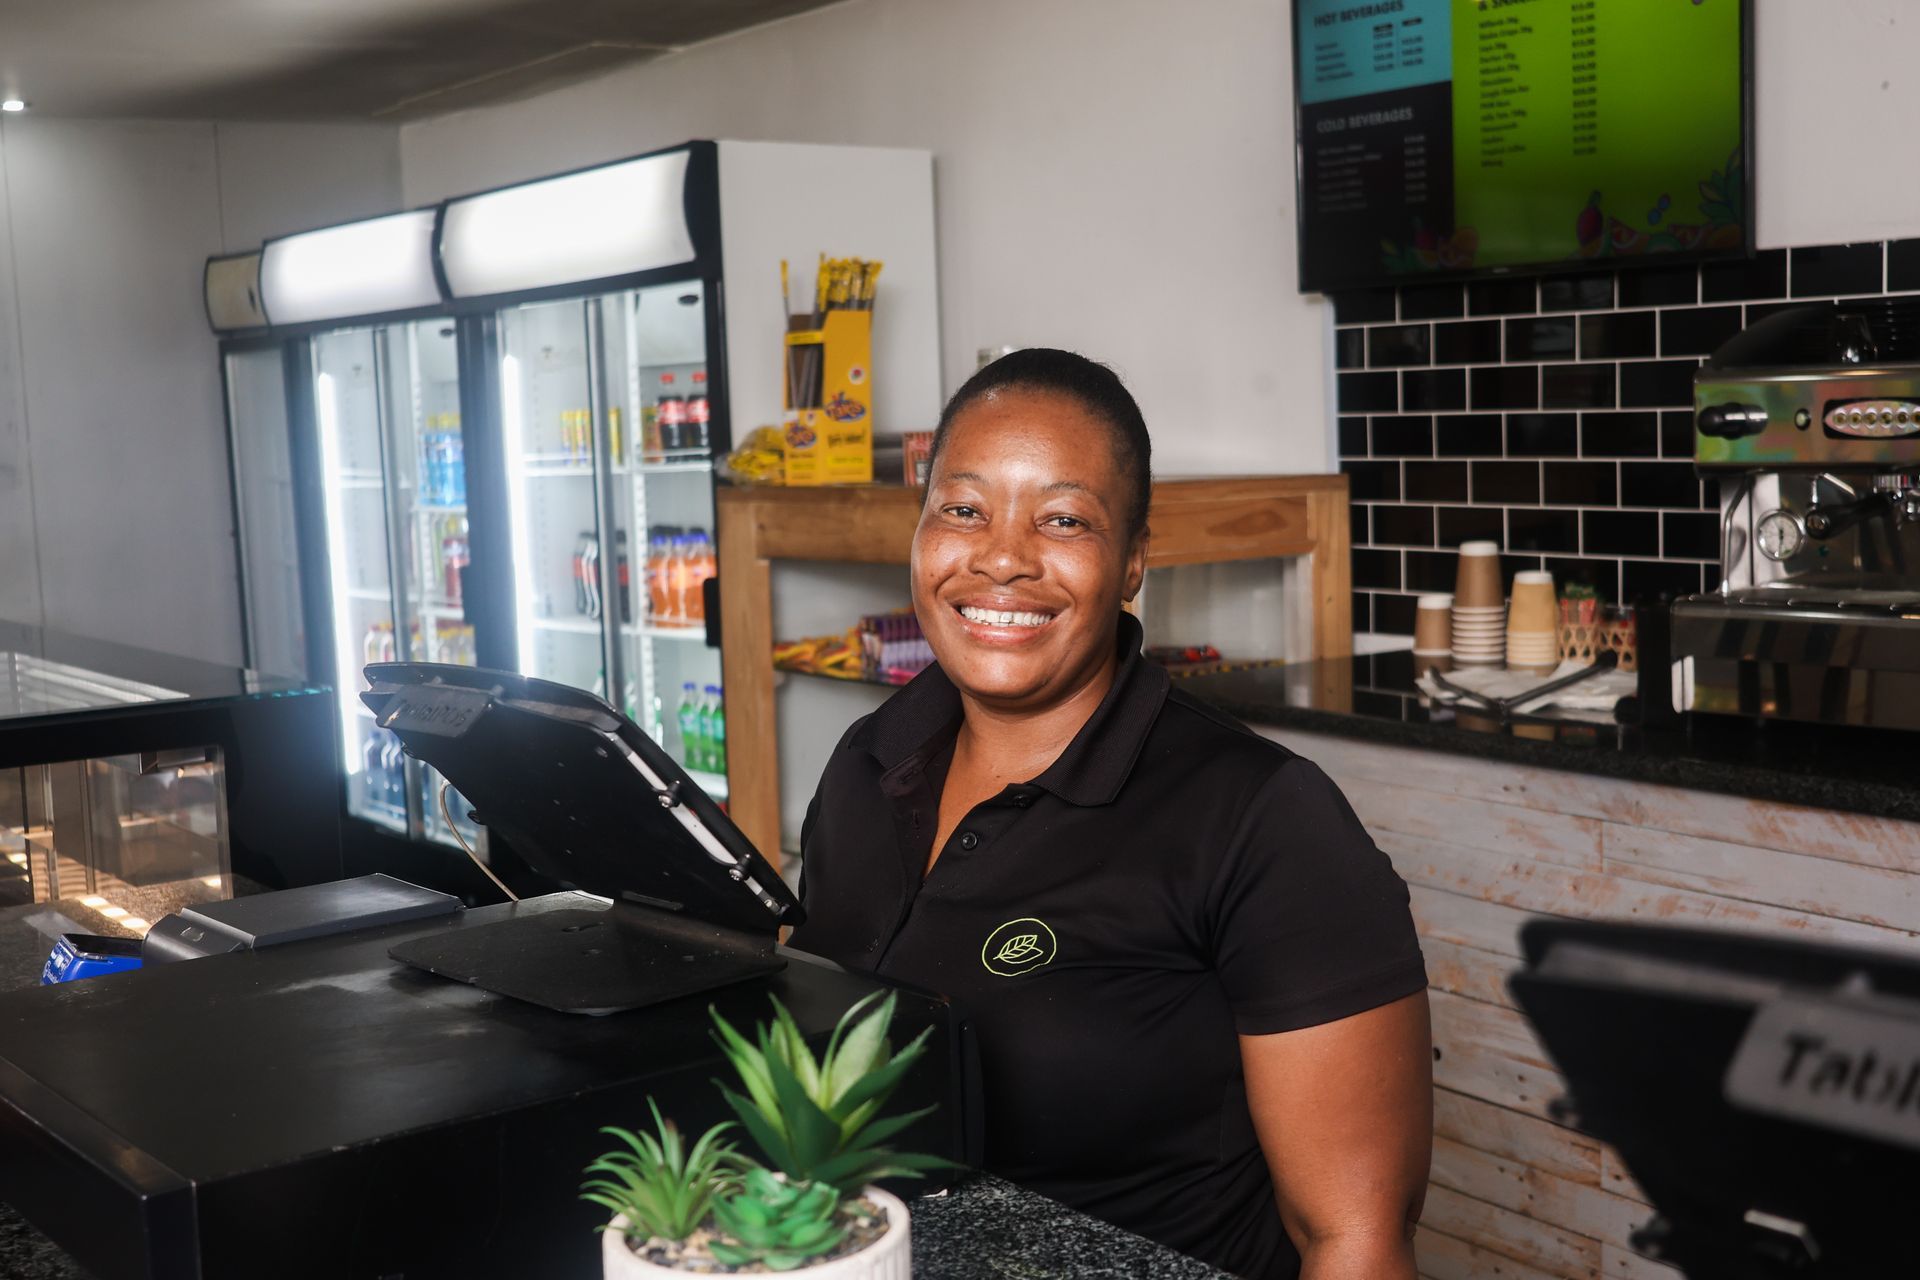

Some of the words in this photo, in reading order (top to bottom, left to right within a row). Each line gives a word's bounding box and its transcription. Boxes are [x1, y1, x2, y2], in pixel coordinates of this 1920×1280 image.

[1314, 12, 1337, 28] HOT
[1340, 0, 1404, 22] BEVERAGES
[1316, 117, 1345, 133] COLD
[1349, 107, 1413, 128] BEVERAGES
[1778, 1030, 1920, 1114] Tabl
